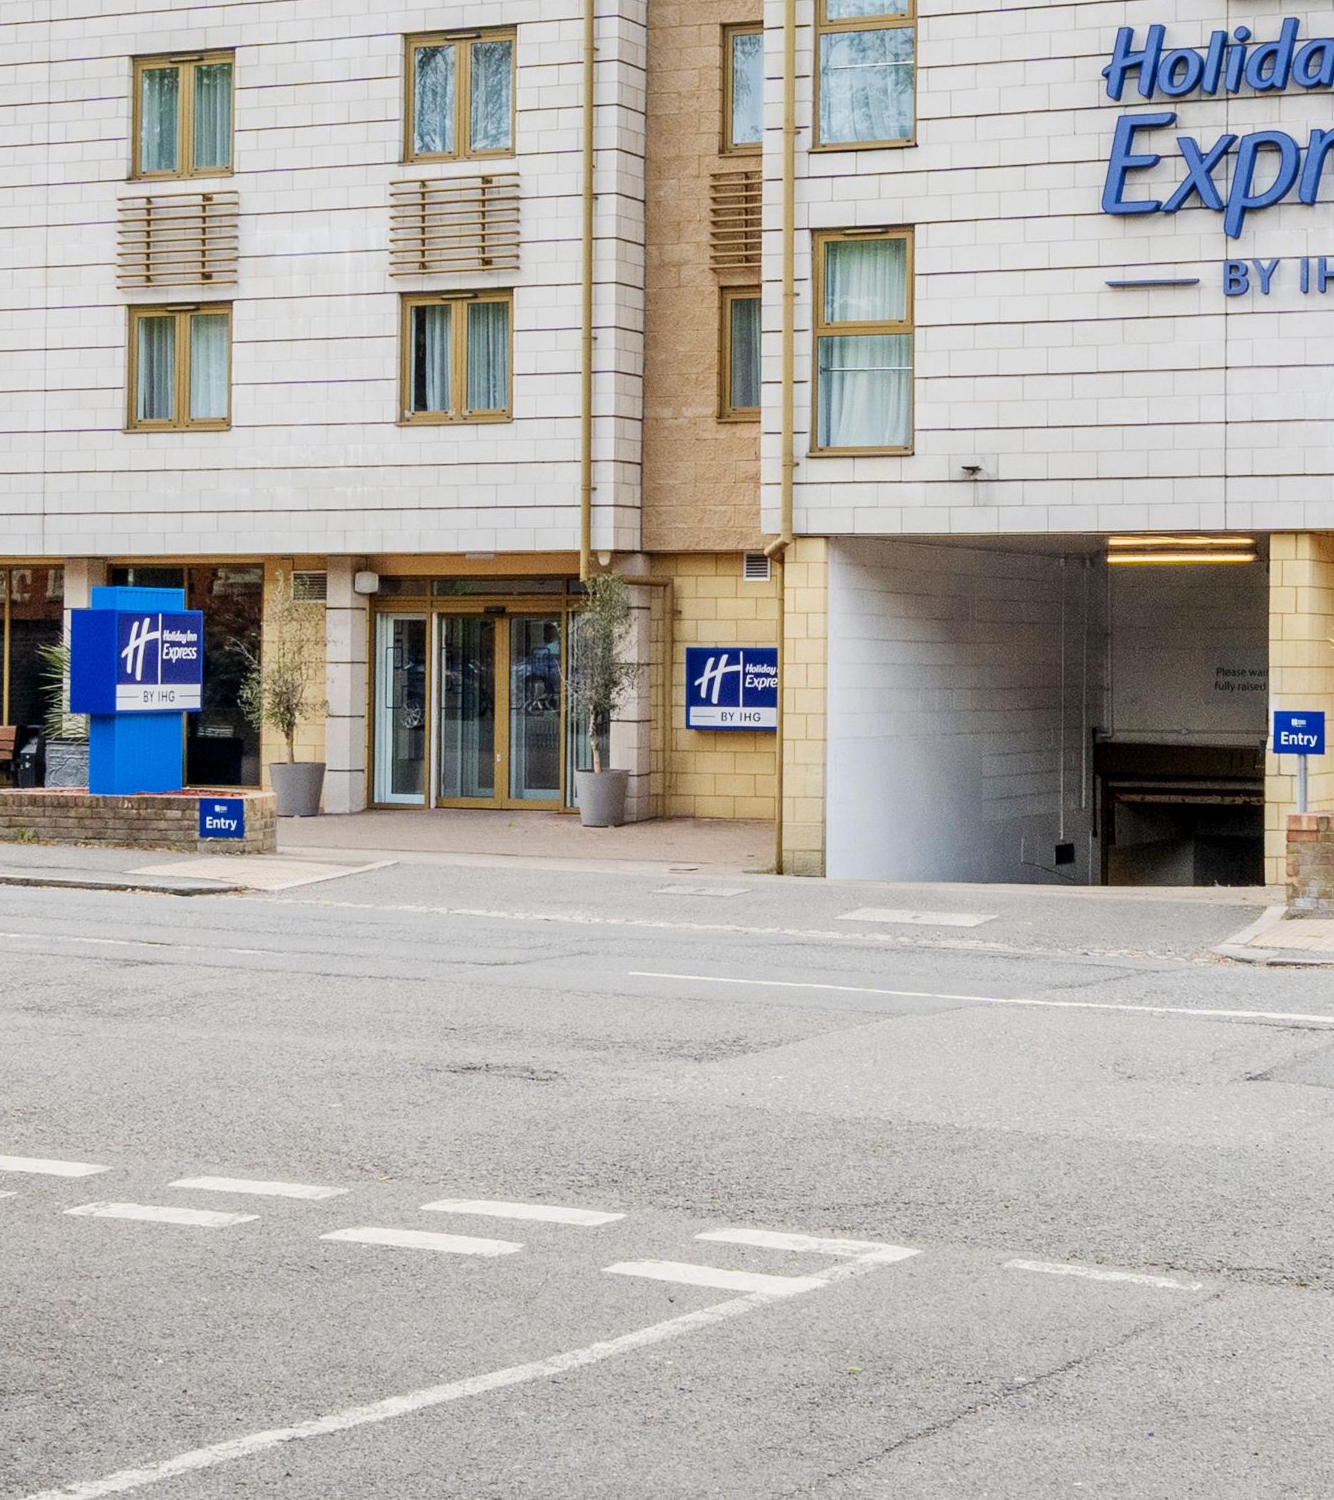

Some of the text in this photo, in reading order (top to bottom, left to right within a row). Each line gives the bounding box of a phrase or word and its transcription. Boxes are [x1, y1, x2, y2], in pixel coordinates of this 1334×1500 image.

[1222, 257, 1279, 297] BY
[162, 629, 187, 645] Holiday
[162, 643, 198, 664] Express
[745, 664, 776, 675] Holiday
[1216, 666, 1247, 678] Please
[745, 675, 777, 690] Expre
[1214, 681, 1266, 693] fully raised
[143, 690, 175, 702] BY IHG
[721, 712, 761, 722] BY IHG
[1280, 731, 1318, 747] Entry
[205, 816, 237, 831] Entry
